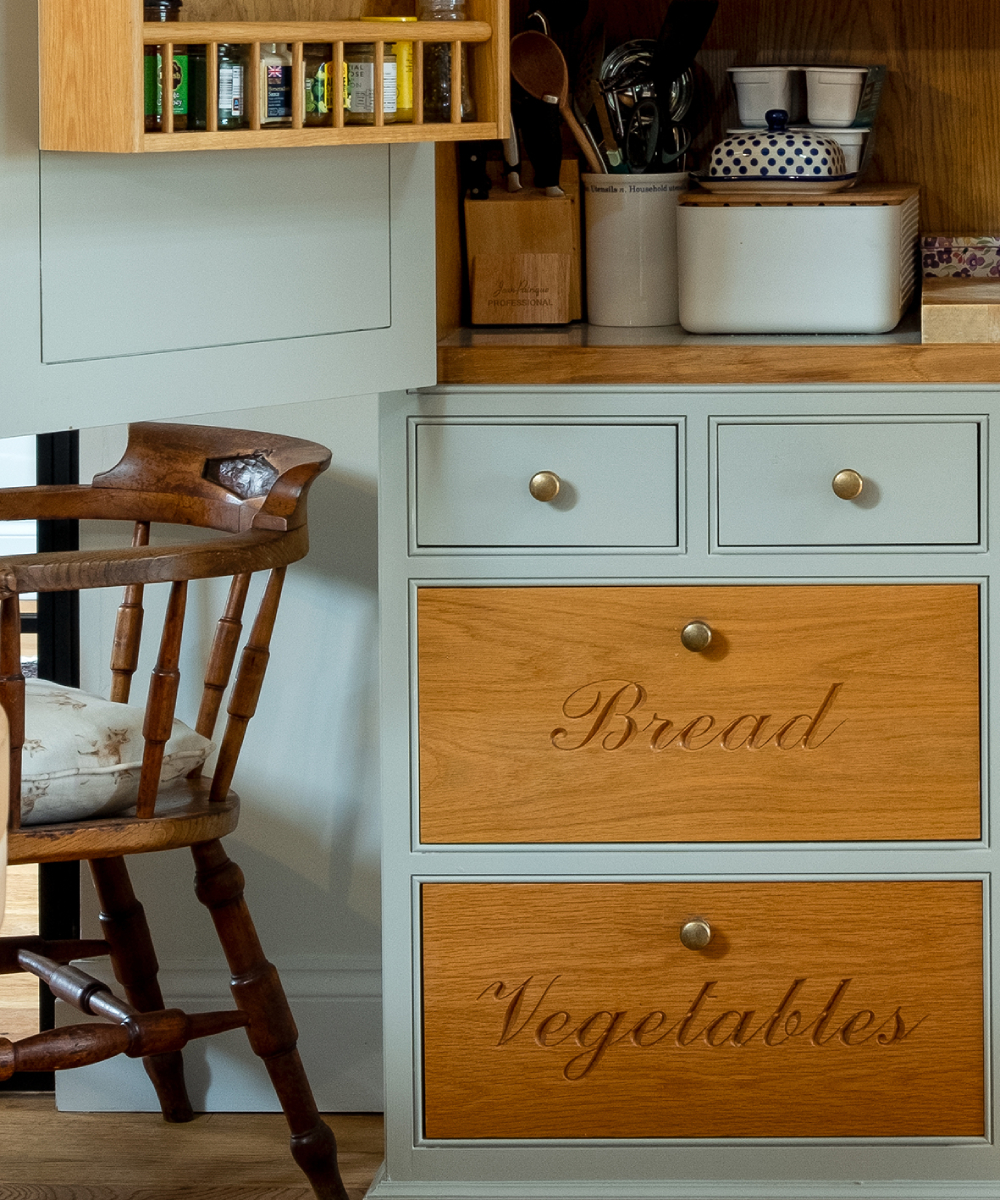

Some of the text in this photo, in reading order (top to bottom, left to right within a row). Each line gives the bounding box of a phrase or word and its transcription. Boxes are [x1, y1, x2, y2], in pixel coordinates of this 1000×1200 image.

[590, 185, 618, 193] Utensils
[629, 184, 668, 193] Household
[549, 679, 848, 752] Bread
[477, 974, 930, 1082] Vegetables
